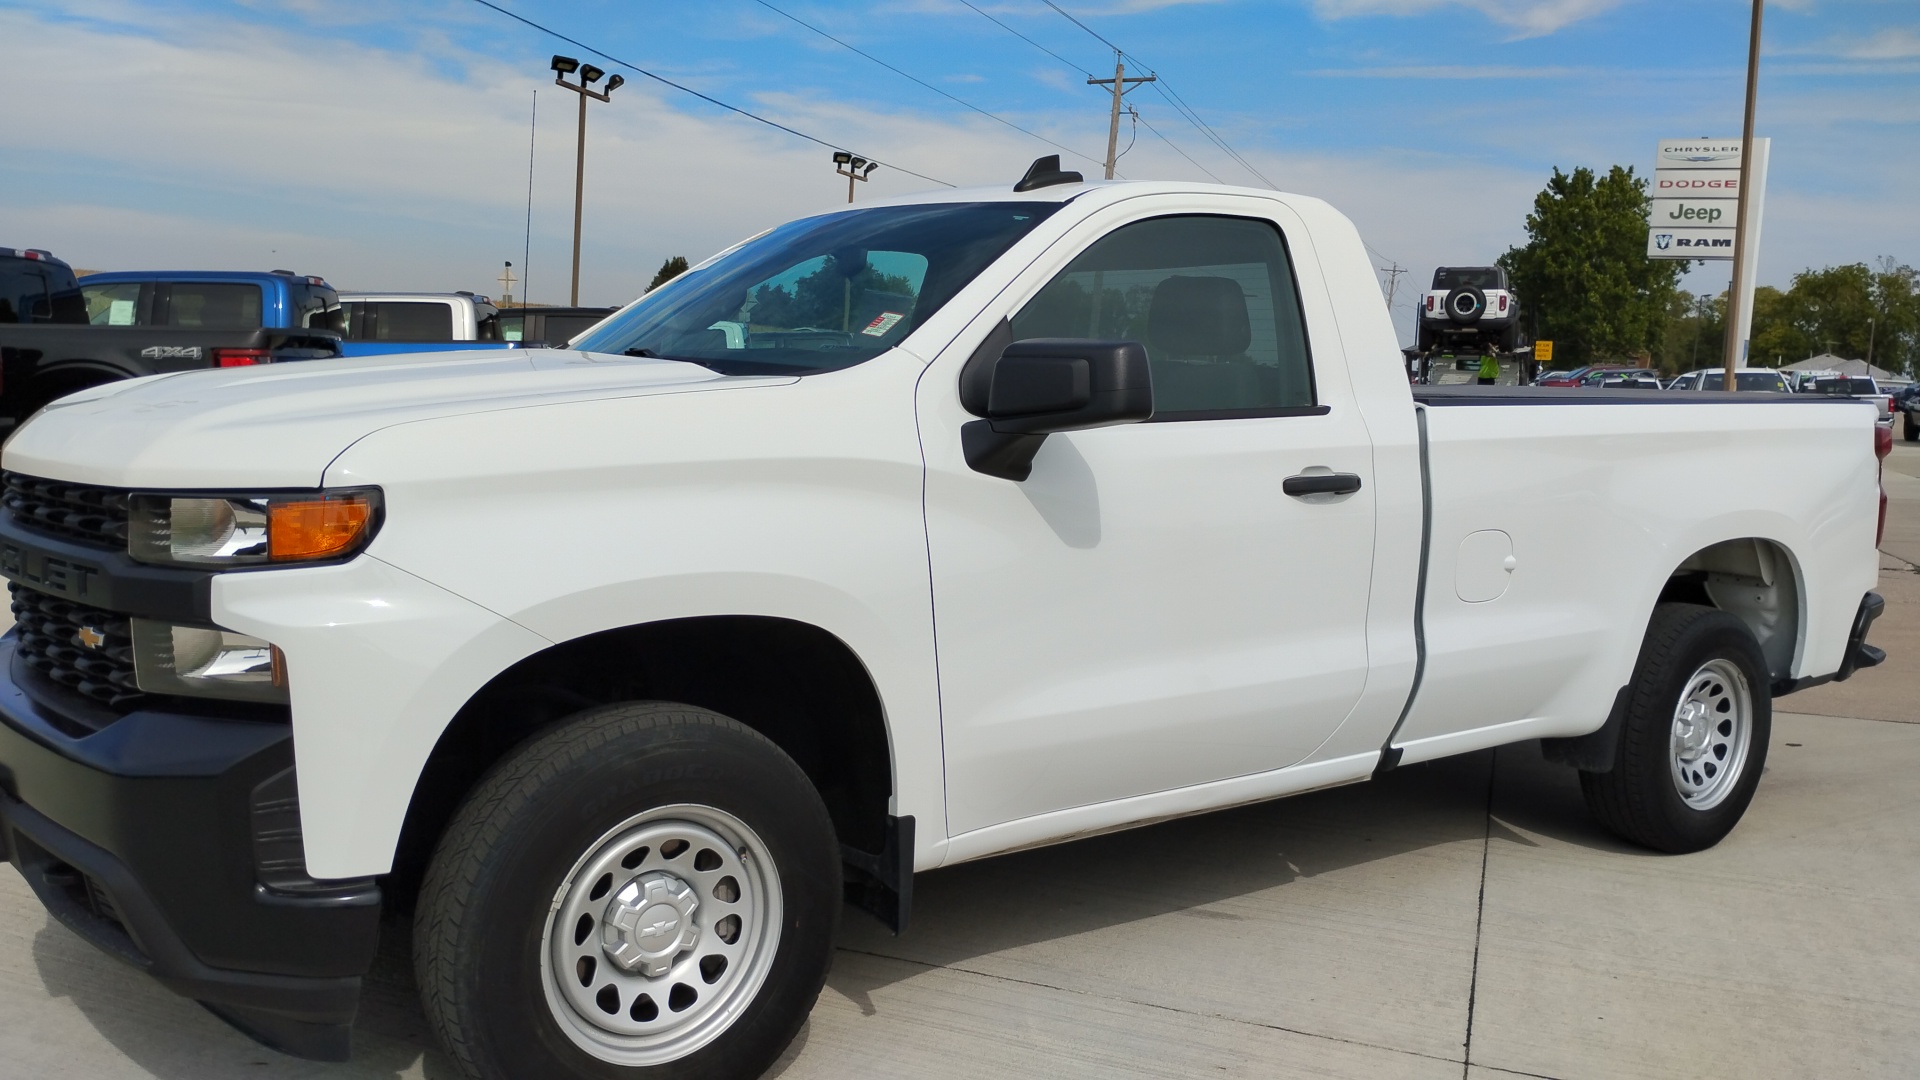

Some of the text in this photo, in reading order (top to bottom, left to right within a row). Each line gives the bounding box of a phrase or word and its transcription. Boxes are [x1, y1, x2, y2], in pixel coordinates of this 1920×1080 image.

[1659, 180, 1738, 189] DODGE
[1669, 203, 1722, 223] Jeep
[1676, 238, 1732, 247] RAM
